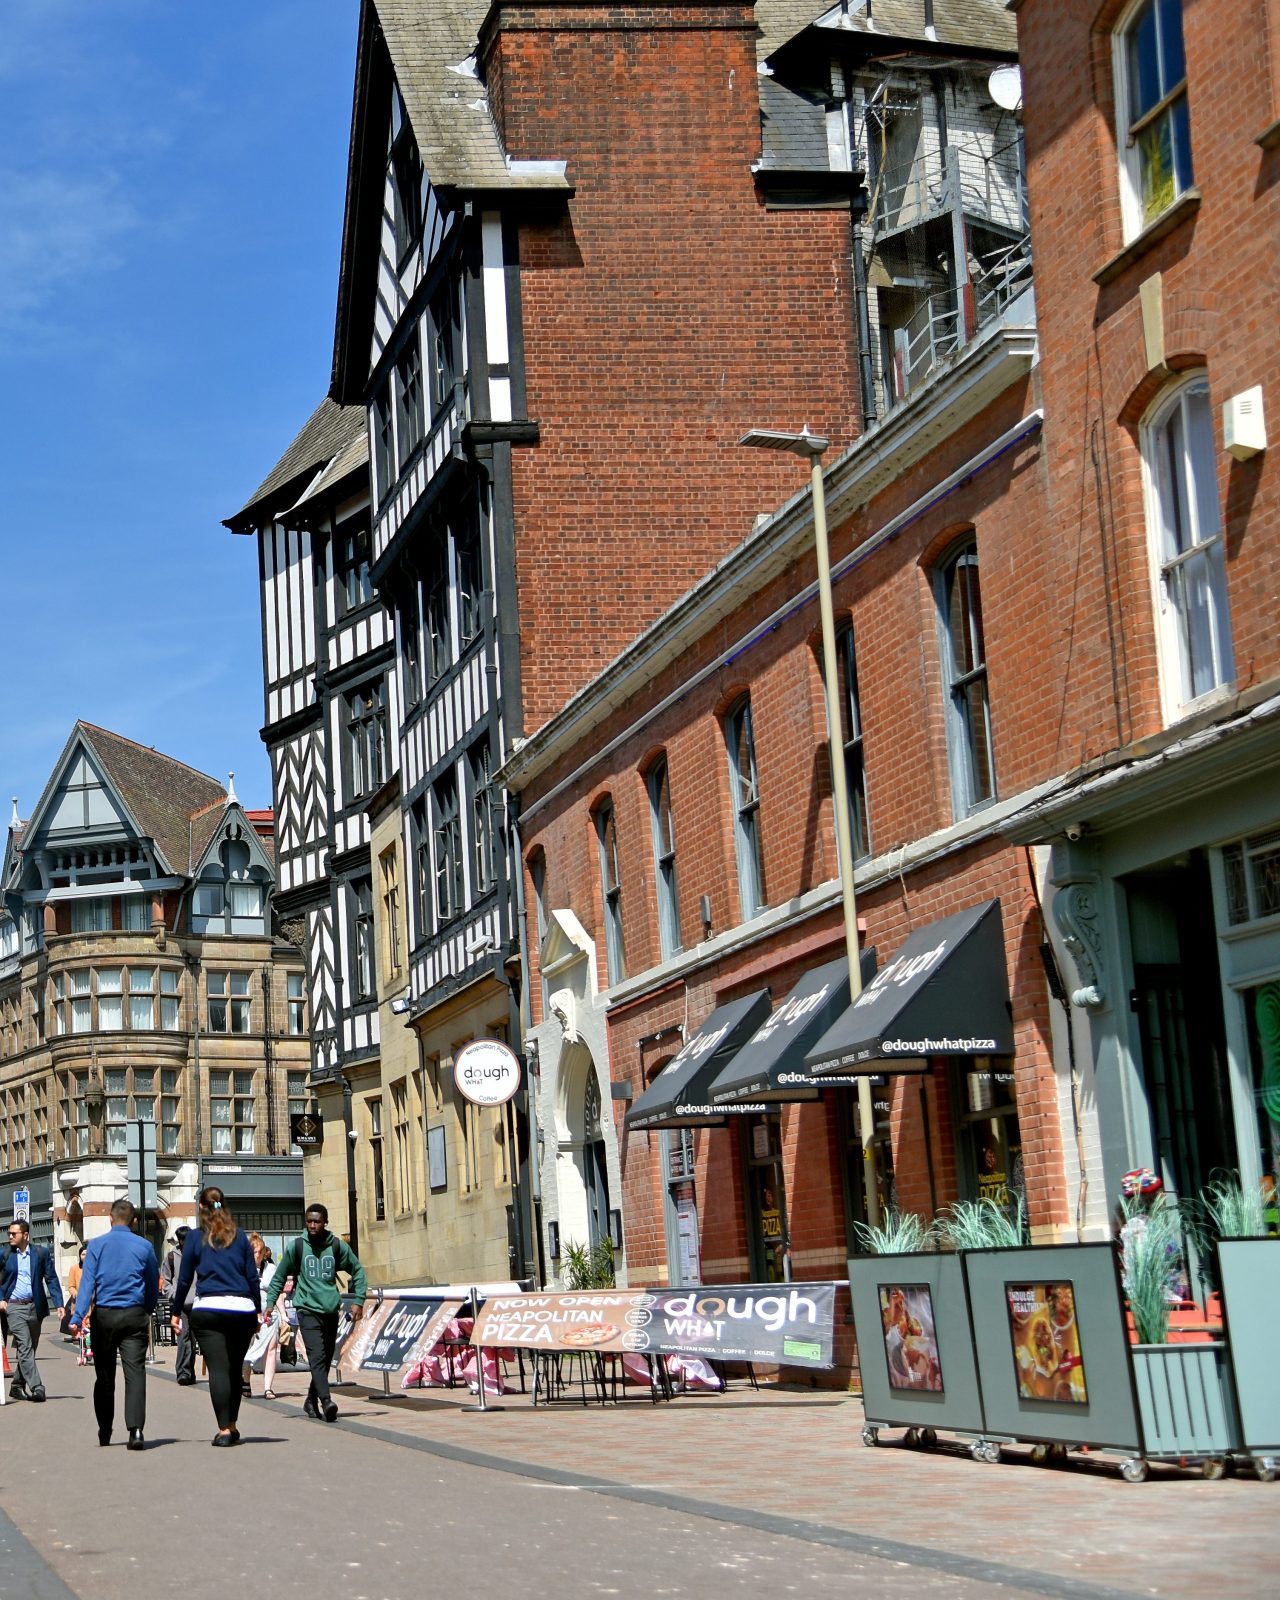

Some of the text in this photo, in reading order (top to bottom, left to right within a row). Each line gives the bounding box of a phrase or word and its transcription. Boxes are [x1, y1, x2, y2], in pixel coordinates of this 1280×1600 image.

[882, 1037, 996, 1053] @doughwhatpizza
[464, 1065, 509, 1080] dough
[763, 1217, 781, 1236] PIZZA
[493, 1298, 552, 1311] NOW
[558, 1296, 621, 1306] OPEN
[664, 1290, 816, 1331] dough
[486, 1310, 603, 1323] NEAPOLITAN
[384, 1305, 431, 1348] dough
[482, 1323, 553, 1343] PIZZA
[664, 1319, 726, 1340] WHAT
